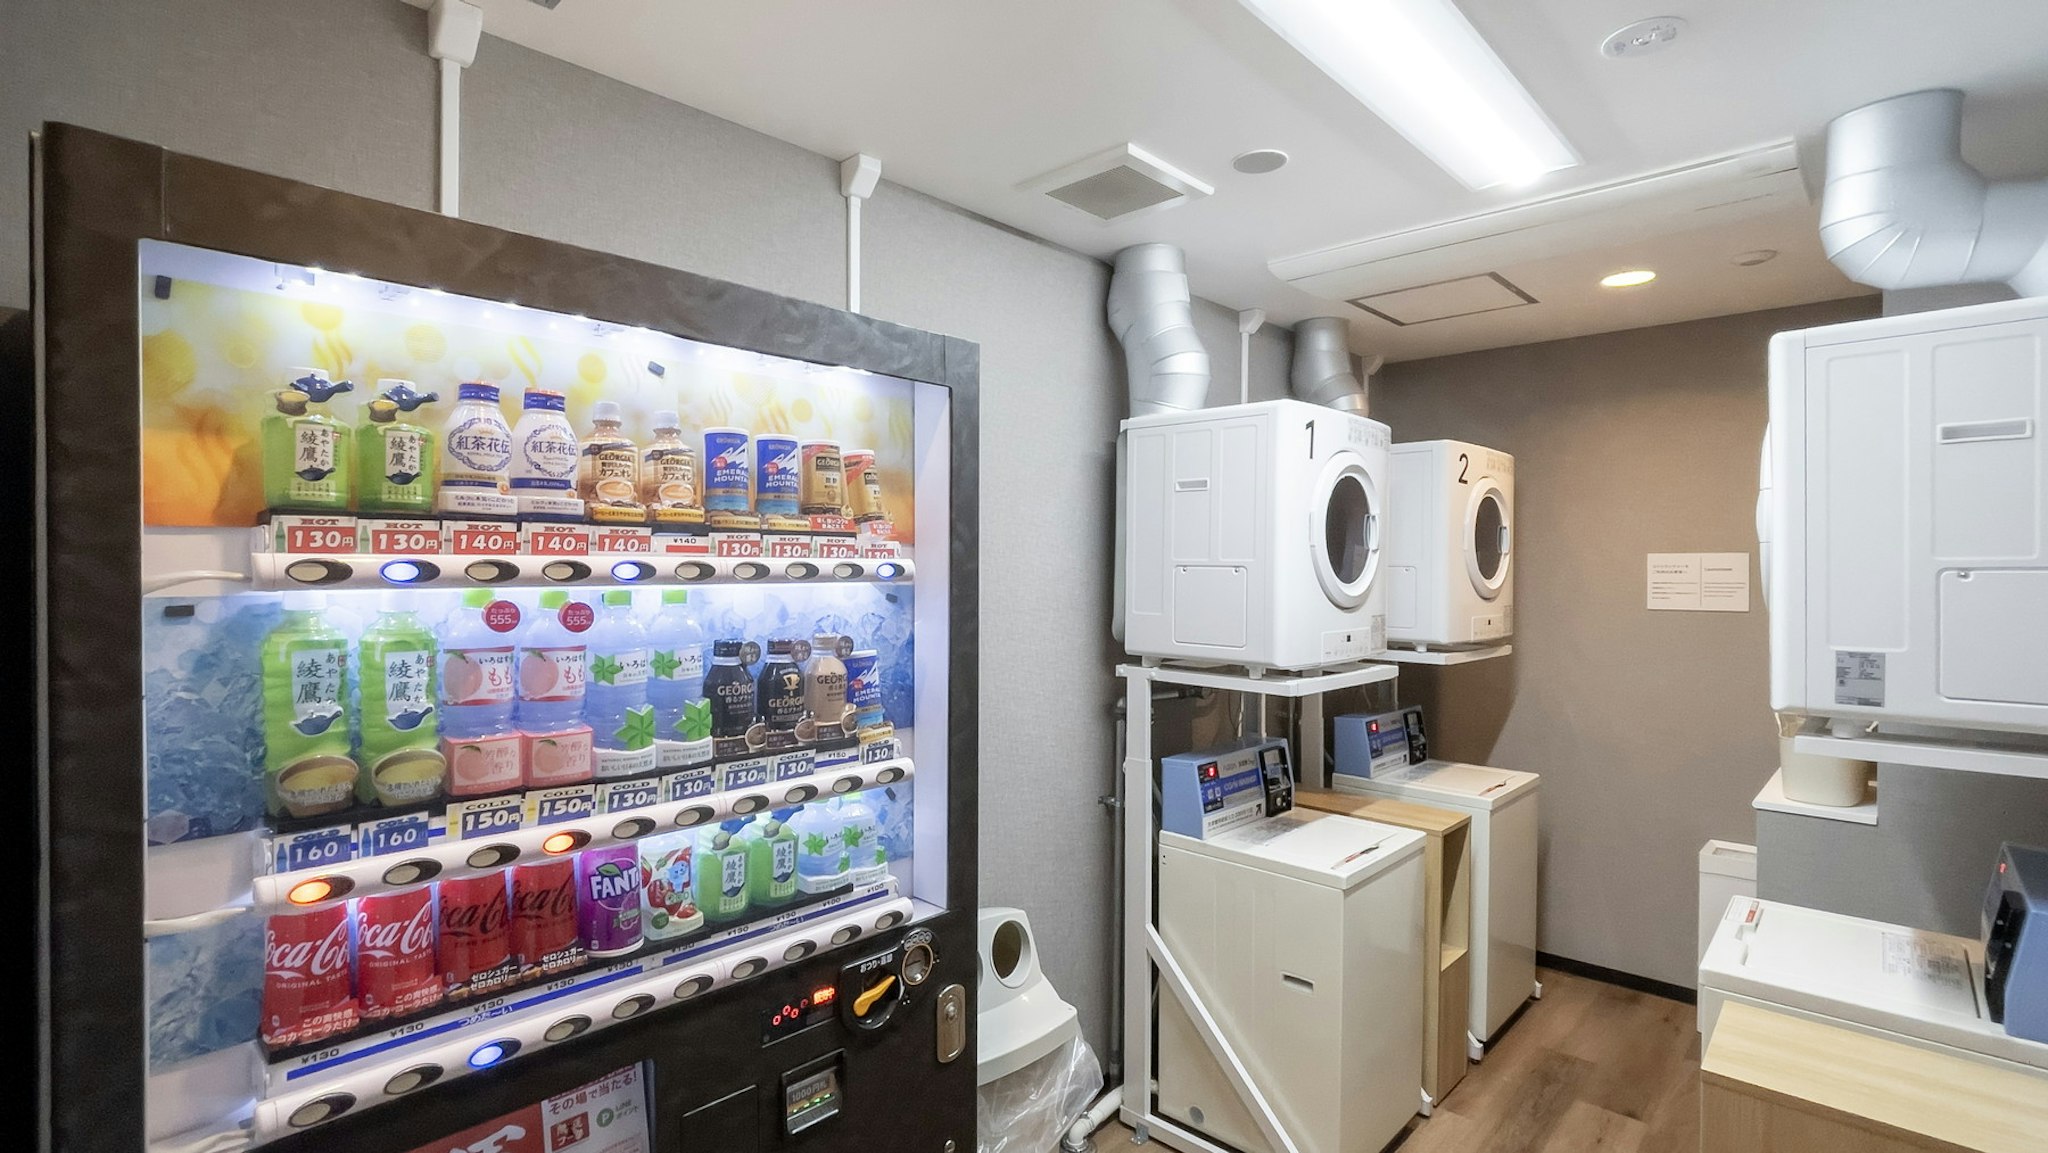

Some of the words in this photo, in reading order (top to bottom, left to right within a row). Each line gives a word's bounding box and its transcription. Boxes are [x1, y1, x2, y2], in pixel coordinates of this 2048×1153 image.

[455, 434, 511, 455] 紅茶花伝
[530, 439, 577, 456] 紅茶花伝
[1305, 420, 1315, 459] 1
[1458, 453, 1469, 485] 2
[301, 518, 339, 526] HOT
[295, 530, 354, 548] 130円
[379, 533, 438, 551] 130円
[459, 534, 515, 551] 140円
[536, 535, 587, 551] 140円
[602, 538, 650, 552] 140円
[720, 542, 760, 557] 130円
[774, 544, 810, 558] 130円
[296, 658, 325, 704] 綾鷹
[388, 659, 414, 702] 綾鷹
[488, 666, 513, 687] もも
[728, 760, 761, 770] COLD
[779, 752, 809, 761] COLD
[674, 770, 705, 780] COLD
[778, 760, 815, 777] 130円
[612, 781, 650, 791] COLD
[728, 769, 767, 786] 130円
[542, 788, 585, 799] COLD
[675, 780, 712, 798] 130円
[466, 799, 511, 811] COLD
[541, 797, 592, 817] 150円
[612, 792, 657, 809] 130円
[465, 809, 520, 831] 150円
[541, 946, 584, 963] ゼロシュガー
[471, 964, 518, 982] ゼロシュガー
[546, 978, 575, 993] ¥130
[473, 998, 504, 1014] ¥130
[389, 1023, 425, 1038] ¥130
[301, 1048, 340, 1065] ¥130
